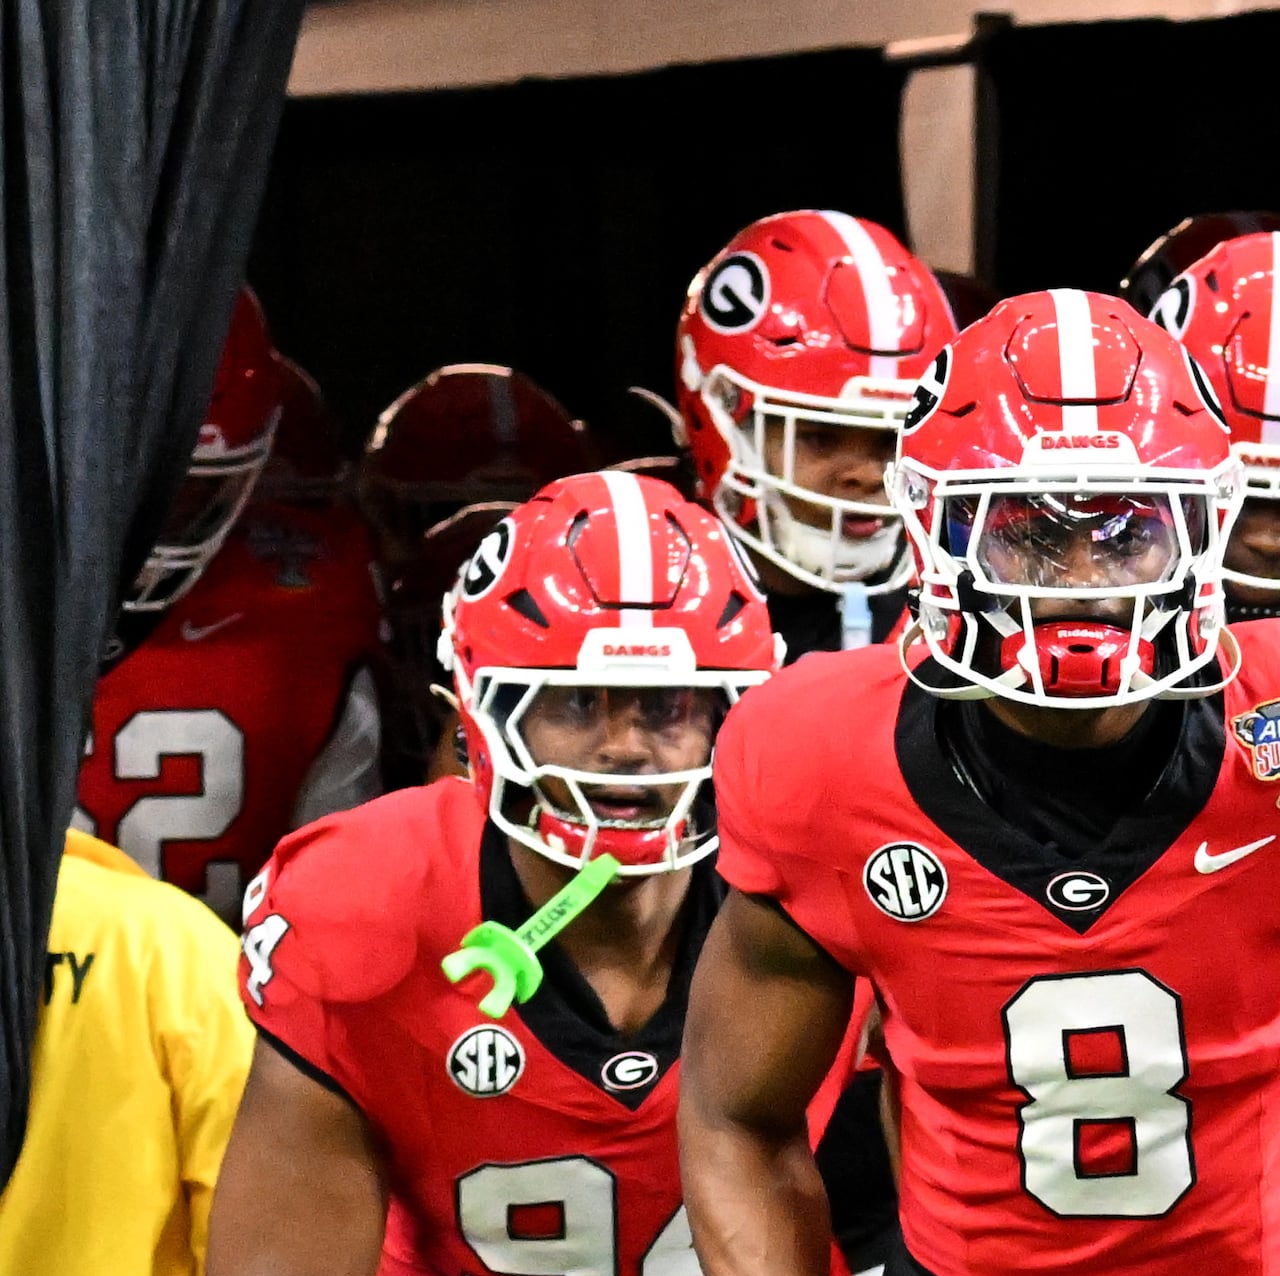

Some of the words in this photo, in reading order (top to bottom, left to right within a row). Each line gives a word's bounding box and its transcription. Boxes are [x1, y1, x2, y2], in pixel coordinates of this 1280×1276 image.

[702, 251, 771, 334] G
[1041, 434, 1120, 450] DAWGS
[602, 644, 672, 657] DAWGS
[84, 709, 245, 920] 2
[868, 848, 941, 917] SEC
[1046, 872, 1109, 911] G
[454, 1030, 518, 1093] SEC
[601, 1051, 658, 1090] G
[1004, 969, 1196, 1217] 8
